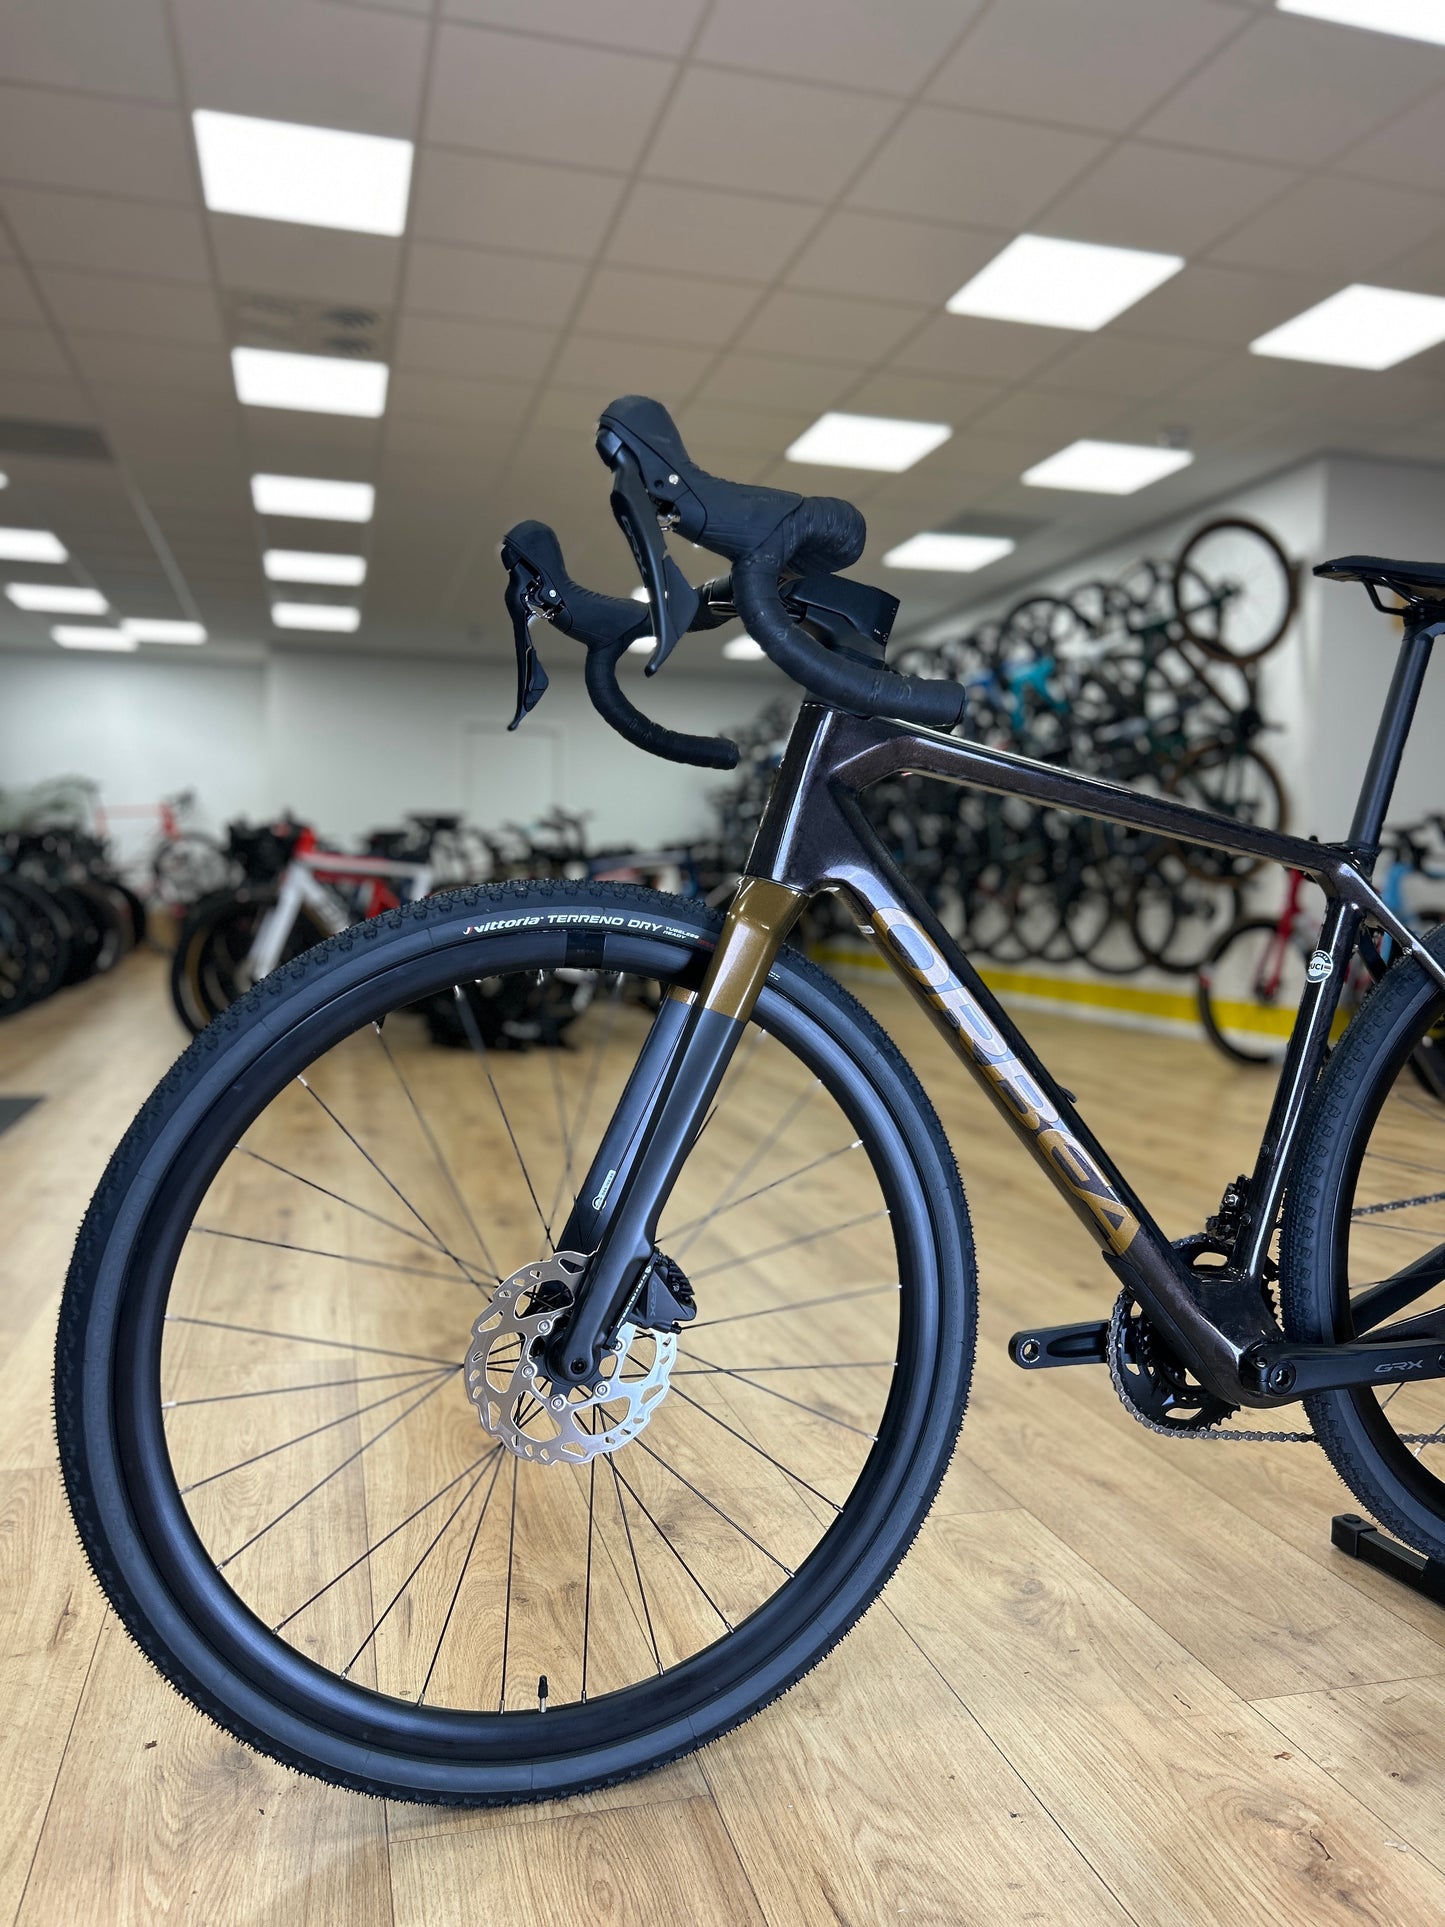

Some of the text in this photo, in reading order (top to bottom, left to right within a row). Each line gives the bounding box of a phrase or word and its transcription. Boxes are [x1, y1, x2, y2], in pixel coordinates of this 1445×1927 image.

[547, 914, 662, 932] TERRENO DRY
[665, 926, 700, 940] TUBELESS
[1310, 962, 1324, 971] UCI
[871, 906, 1141, 1256] ORBEA
[1374, 1359, 1424, 1373] GRX
